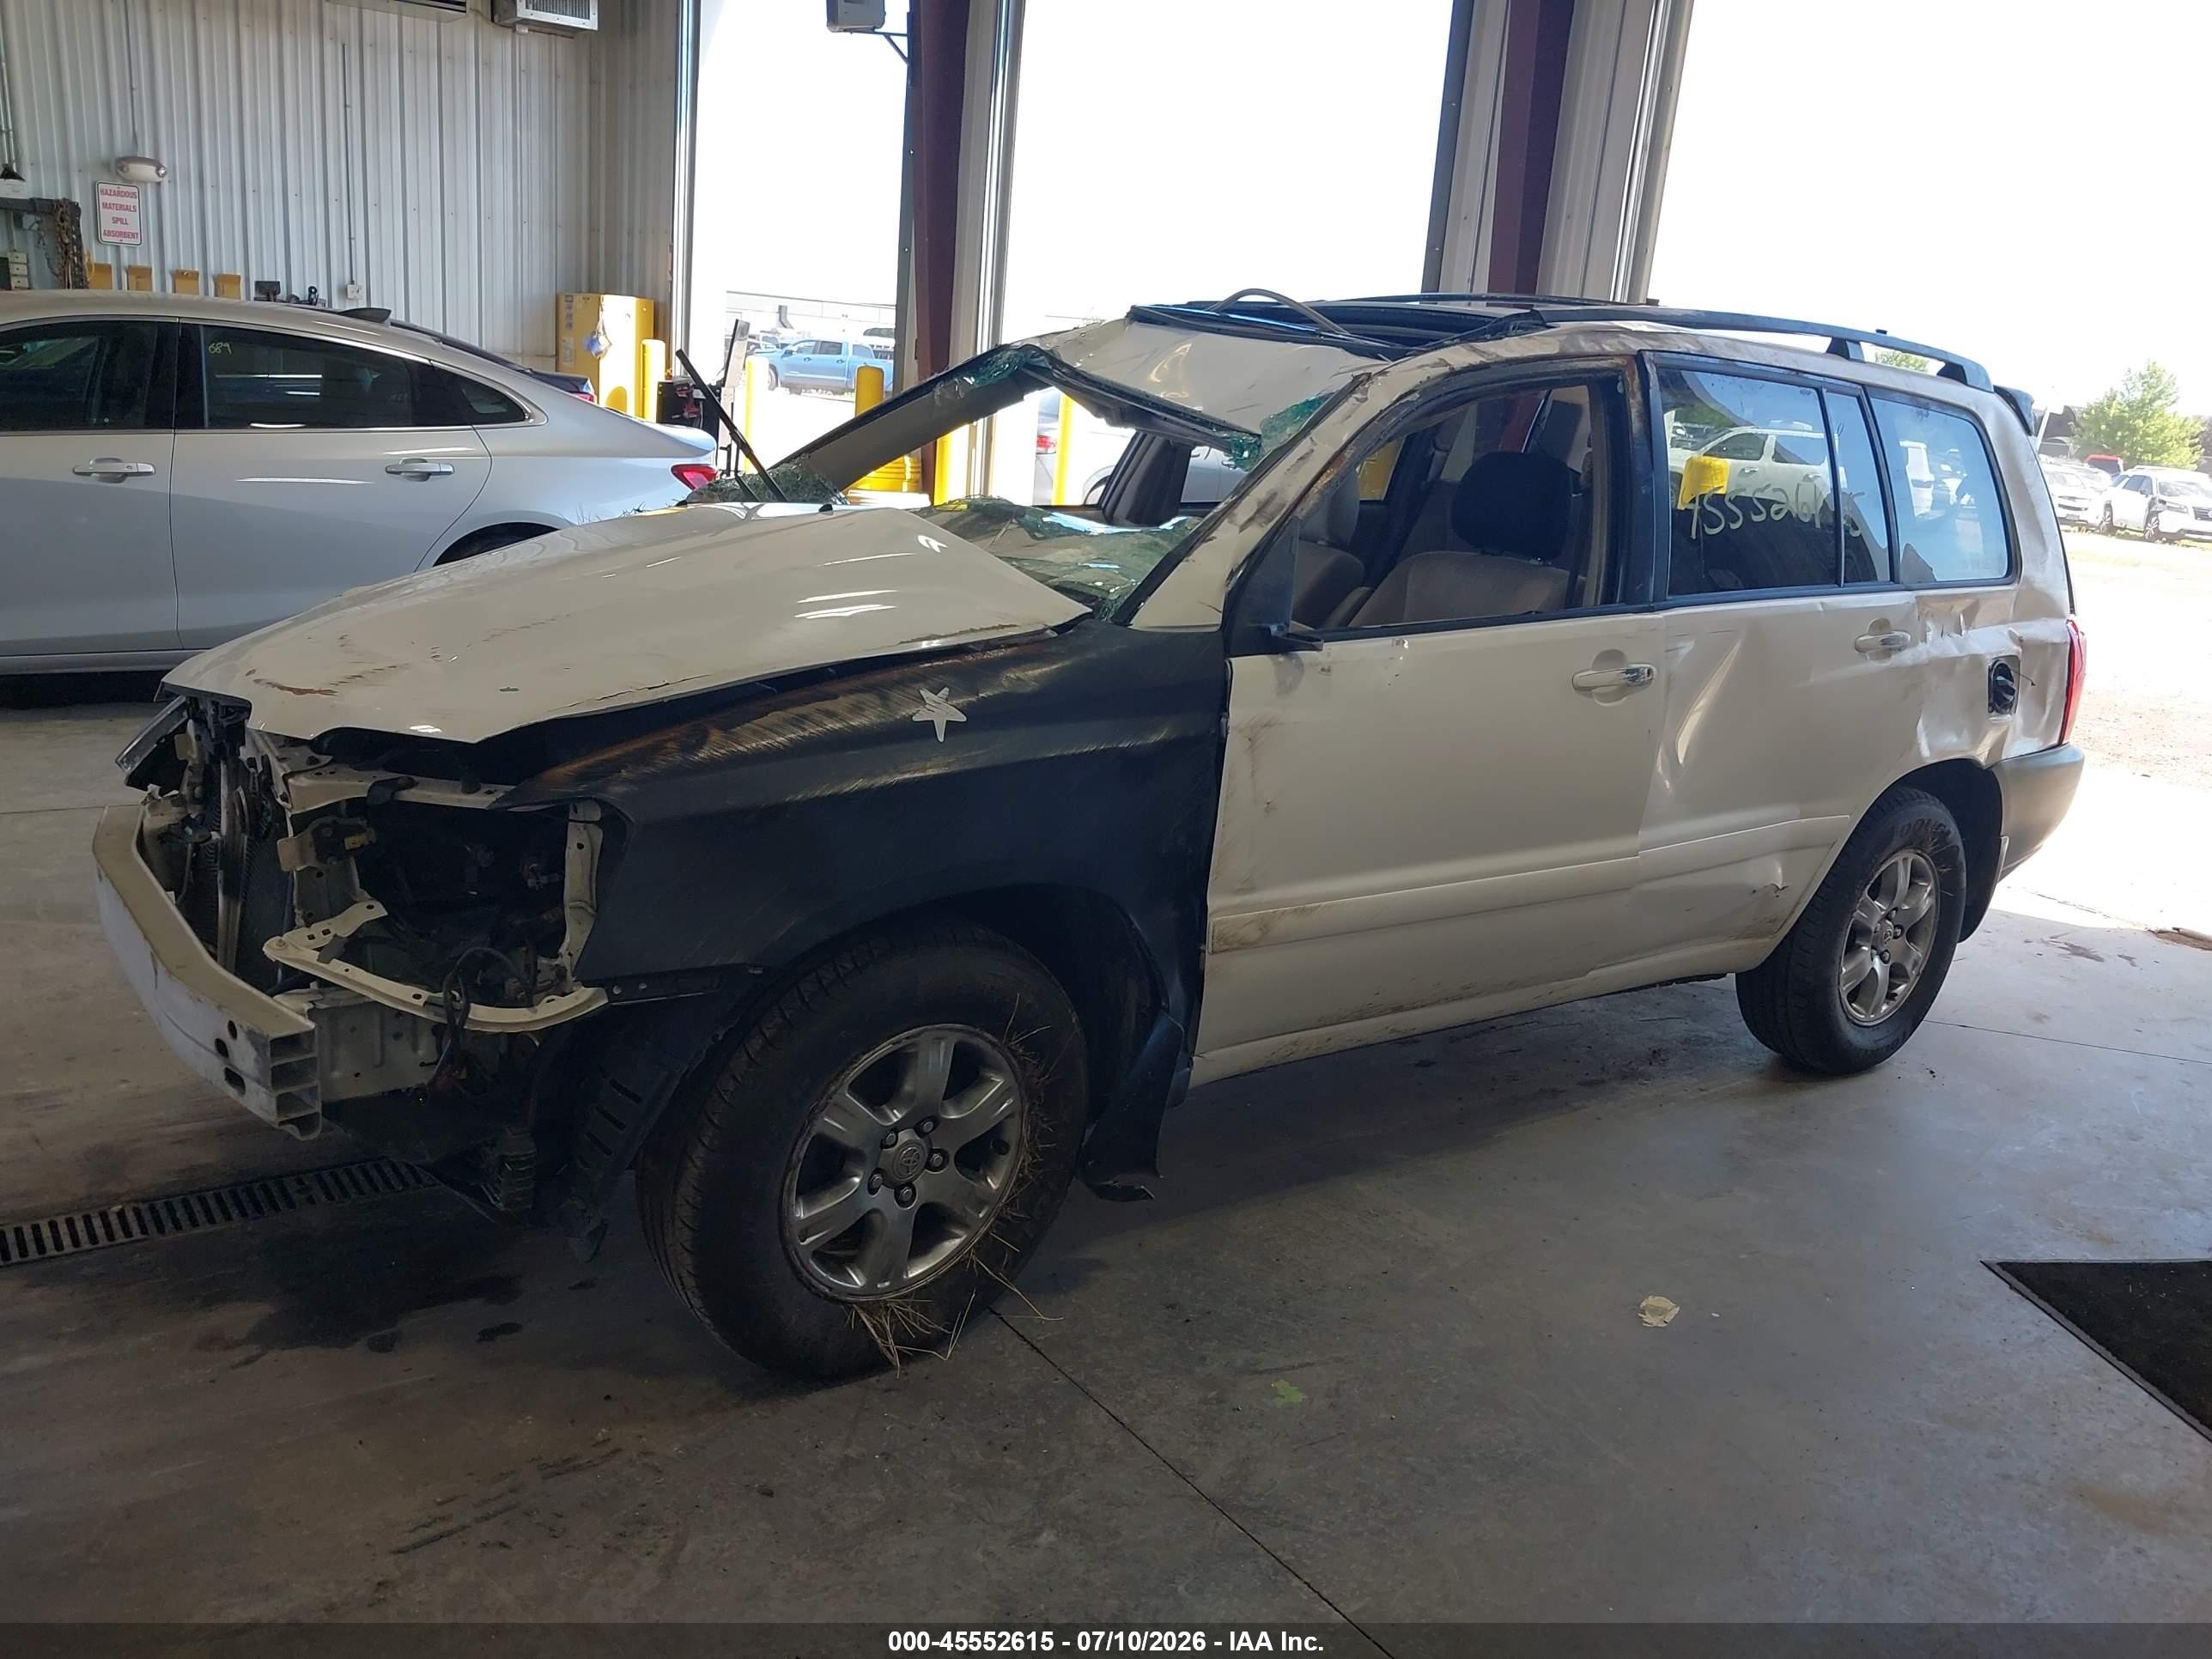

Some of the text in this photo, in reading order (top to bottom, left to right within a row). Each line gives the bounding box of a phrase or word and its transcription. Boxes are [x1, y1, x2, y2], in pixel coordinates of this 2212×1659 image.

[100, 188, 137, 198] HAZARDOUS
[102, 202, 137, 212] MATERIALS
[112, 216, 129, 225] SPILL
[103, 229, 138, 239] ABSORBENT
[208, 342, 232, 355] 689
